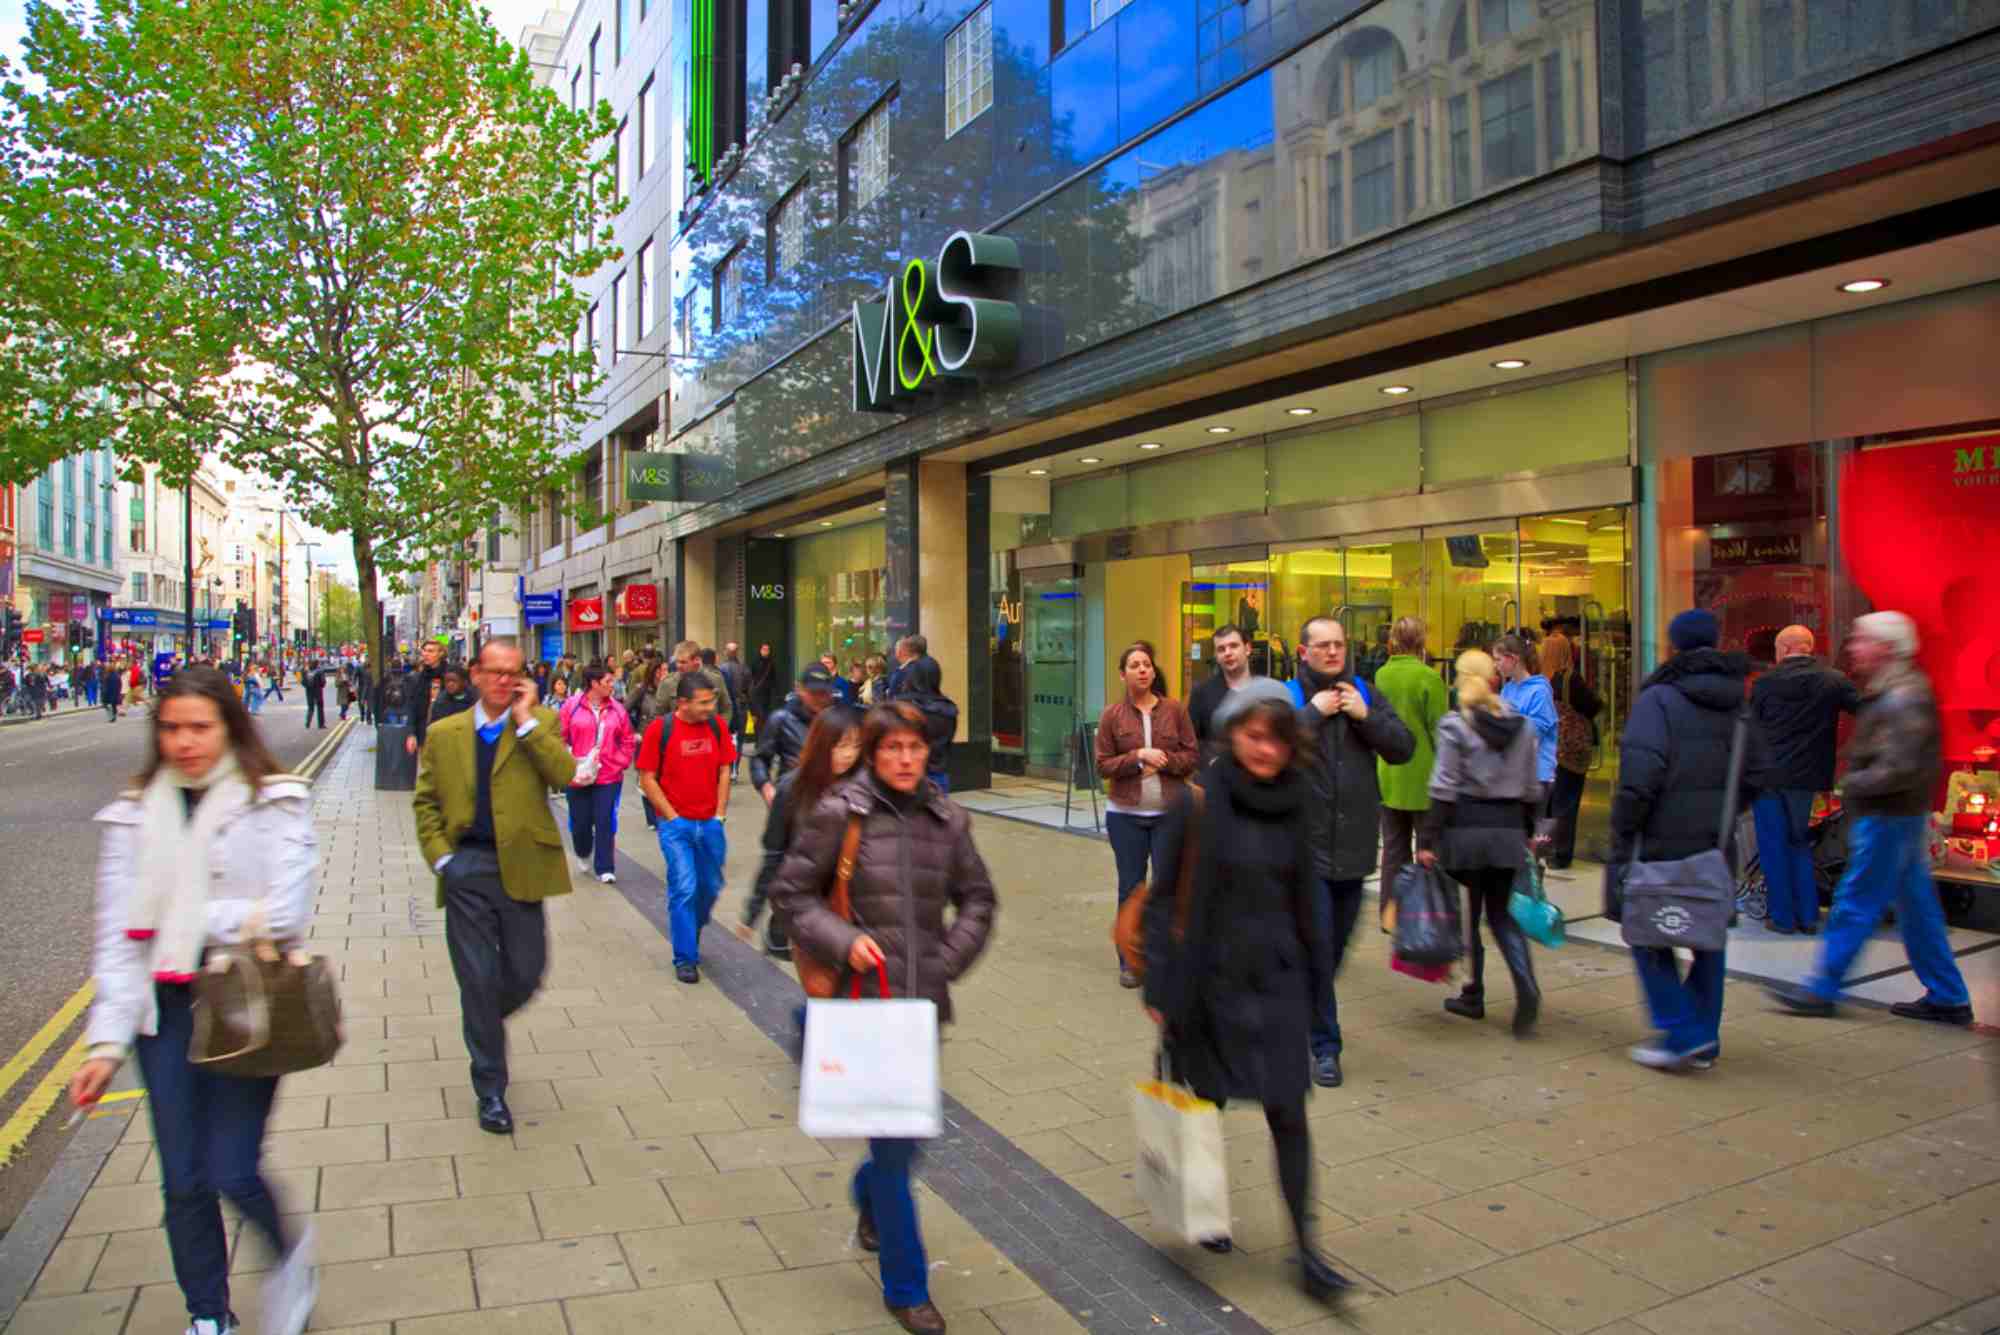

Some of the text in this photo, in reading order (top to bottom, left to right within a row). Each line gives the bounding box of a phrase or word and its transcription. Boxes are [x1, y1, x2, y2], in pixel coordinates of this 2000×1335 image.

[853, 230, 1005, 411] M&S
[631, 466, 670, 486] M&S
[751, 584, 784, 600] M&S
